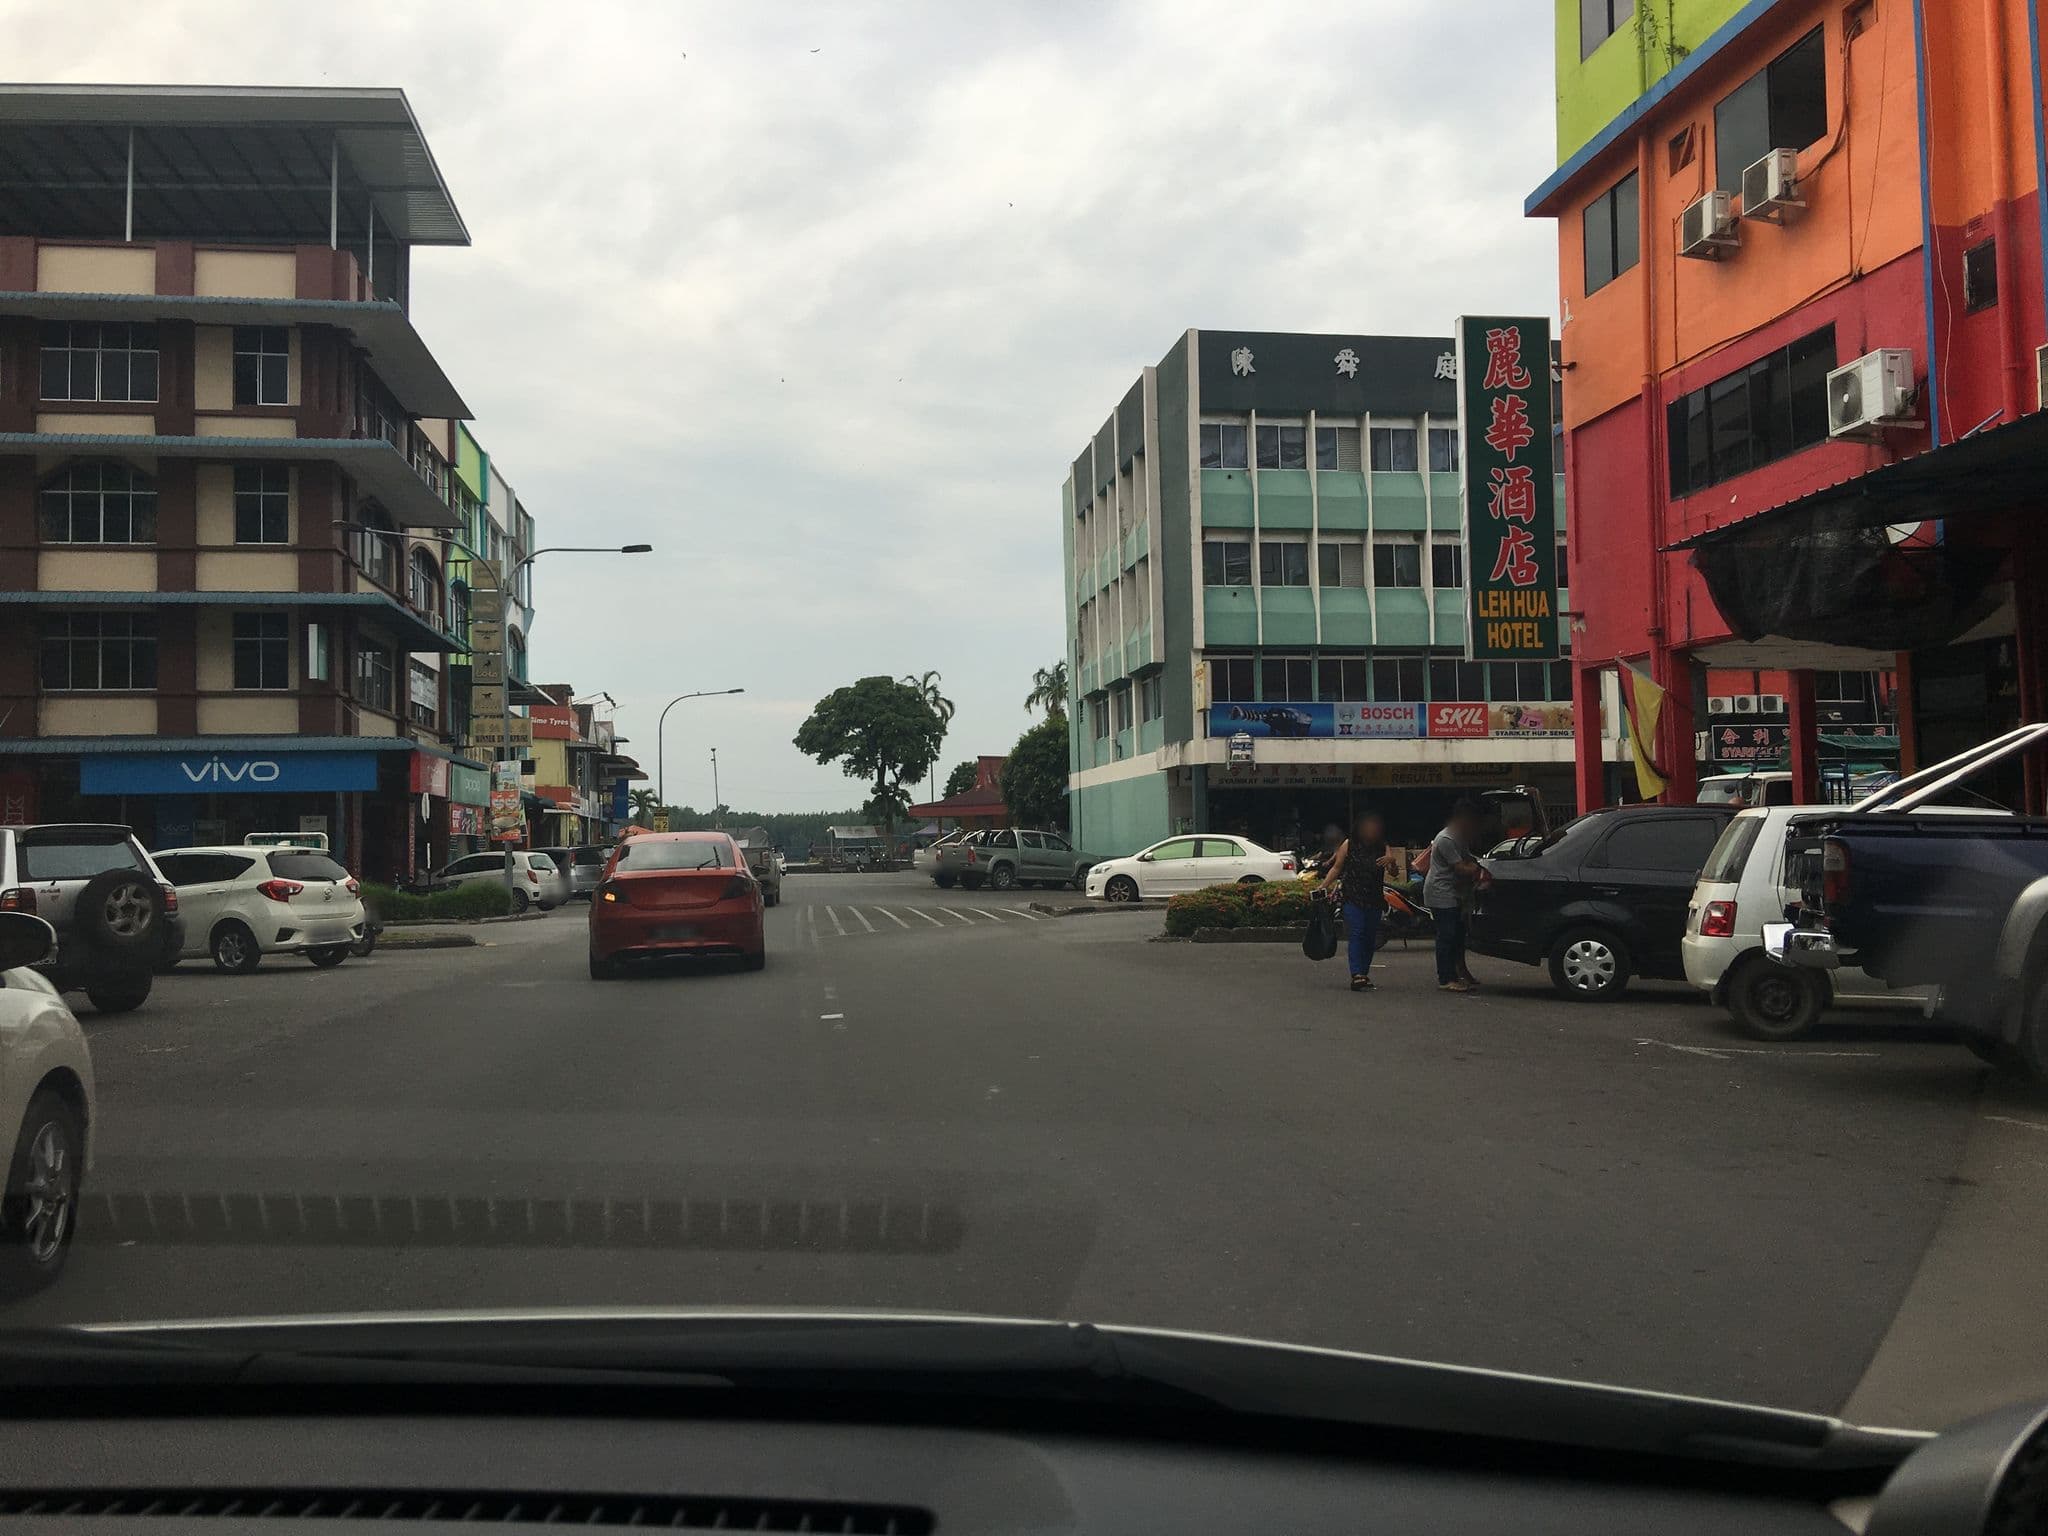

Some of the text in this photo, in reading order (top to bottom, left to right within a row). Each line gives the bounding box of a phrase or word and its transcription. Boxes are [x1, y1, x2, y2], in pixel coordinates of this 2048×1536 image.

[1483, 325, 1540, 587] 麗華酒店
[1478, 590, 1550, 618] LEH HUA
[1487, 622, 1544, 649] HOTEL
[549, 718, 569, 726] Tyres
[1360, 707, 1415, 720] BOSCH
[1434, 707, 1484, 729] SKIL
[180, 756, 281, 783] vivo
[1262, 777, 1281, 785] HUP
